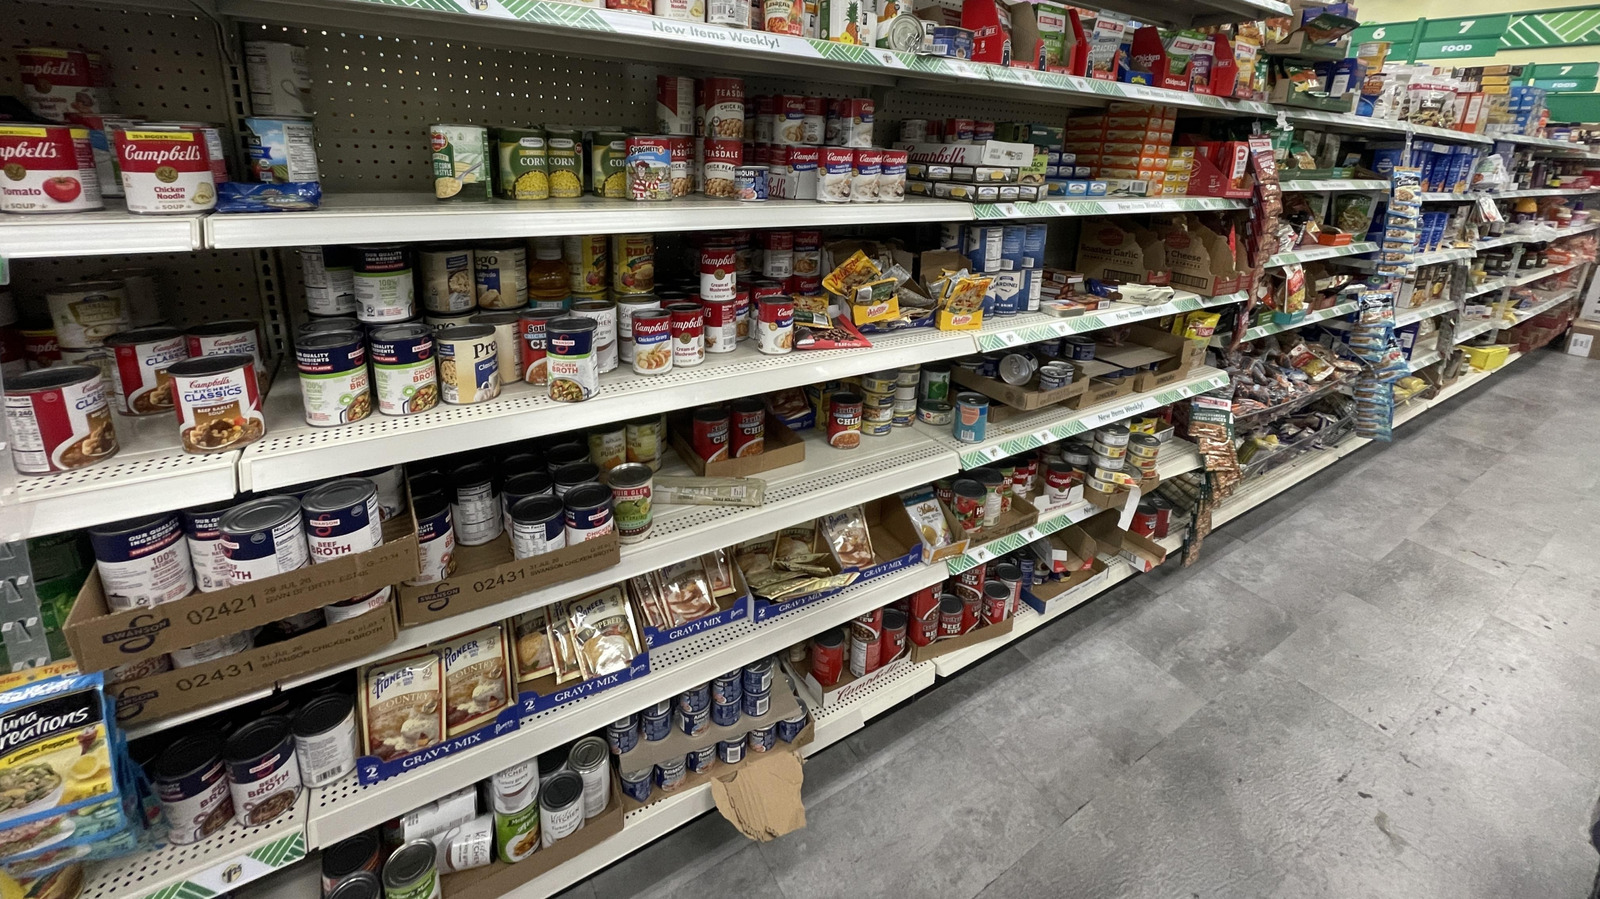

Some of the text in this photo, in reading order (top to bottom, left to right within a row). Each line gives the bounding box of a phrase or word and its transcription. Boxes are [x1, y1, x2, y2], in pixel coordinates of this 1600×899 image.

[651, 20, 781, 50] New Items Weekly!
[1372, 27, 1386, 40] 6
[1458, 20, 1476, 34] 7
[1441, 44, 1473, 53] FOOD
[1560, 66, 1574, 75] 7
[122, 144, 200, 164] Campbell's
[520, 157, 546, 166] CORN
[548, 157, 575, 166] CORN
[704, 149, 738, 158] TEASDALE
[2, 186, 42, 196] Tomato
[1114, 248, 1138, 260] Garlic
[1171, 250, 1202, 262] Cheese
[634, 320, 670, 334] Campbell's
[214, 336, 248, 347] Campbell's
[551, 366, 578, 374] BROTH
[189, 376, 232, 388] Campbell's
[194, 385, 230, 394] KITCHEN
[184, 386, 242, 402] CLASSICS
[212, 404, 234, 412] BARLEY
[1098, 402, 1144, 422] New Items Weekly!
[612, 486, 650, 497] MUIR GLEN
[128, 516, 178, 542] OUR QUALITY
[130, 522, 180, 547] INGREDIENTS
[152, 550, 177, 566] 100%
[311, 544, 352, 556] BROTH
[530, 546, 614, 576] SWANSON CHICKEN BROTH
[864, 560, 903, 578] GRAVY MIX
[279, 582, 296, 592] JUL
[420, 568, 525, 602] SWANSON 02431
[758, 592, 824, 618] 2 GRAVY MIX
[106, 594, 256, 643] SWANSON 02421
[669, 624, 702, 640] GRAVY
[702, 615, 722, 628] MIX
[262, 626, 384, 669] SWANSON CHICKEN BROTH
[444, 640, 479, 672] PIONEER
[176, 660, 254, 692] 02431
[422, 667, 433, 680] 2
[448, 659, 496, 682] COUNTRY
[372, 668, 414, 700] PIONEER
[525, 674, 619, 711] 2 GRAVY MIX
[378, 692, 430, 712] COUNTRY
[0, 706, 90, 750] reations
[8, 736, 76, 765] Lemon Pepper
[366, 732, 482, 778] 2 GRAVY MIX
[248, 770, 290, 798] BROTH
[259, 774, 279, 788] BEEF
[551, 807, 580, 824] KITCHEN
